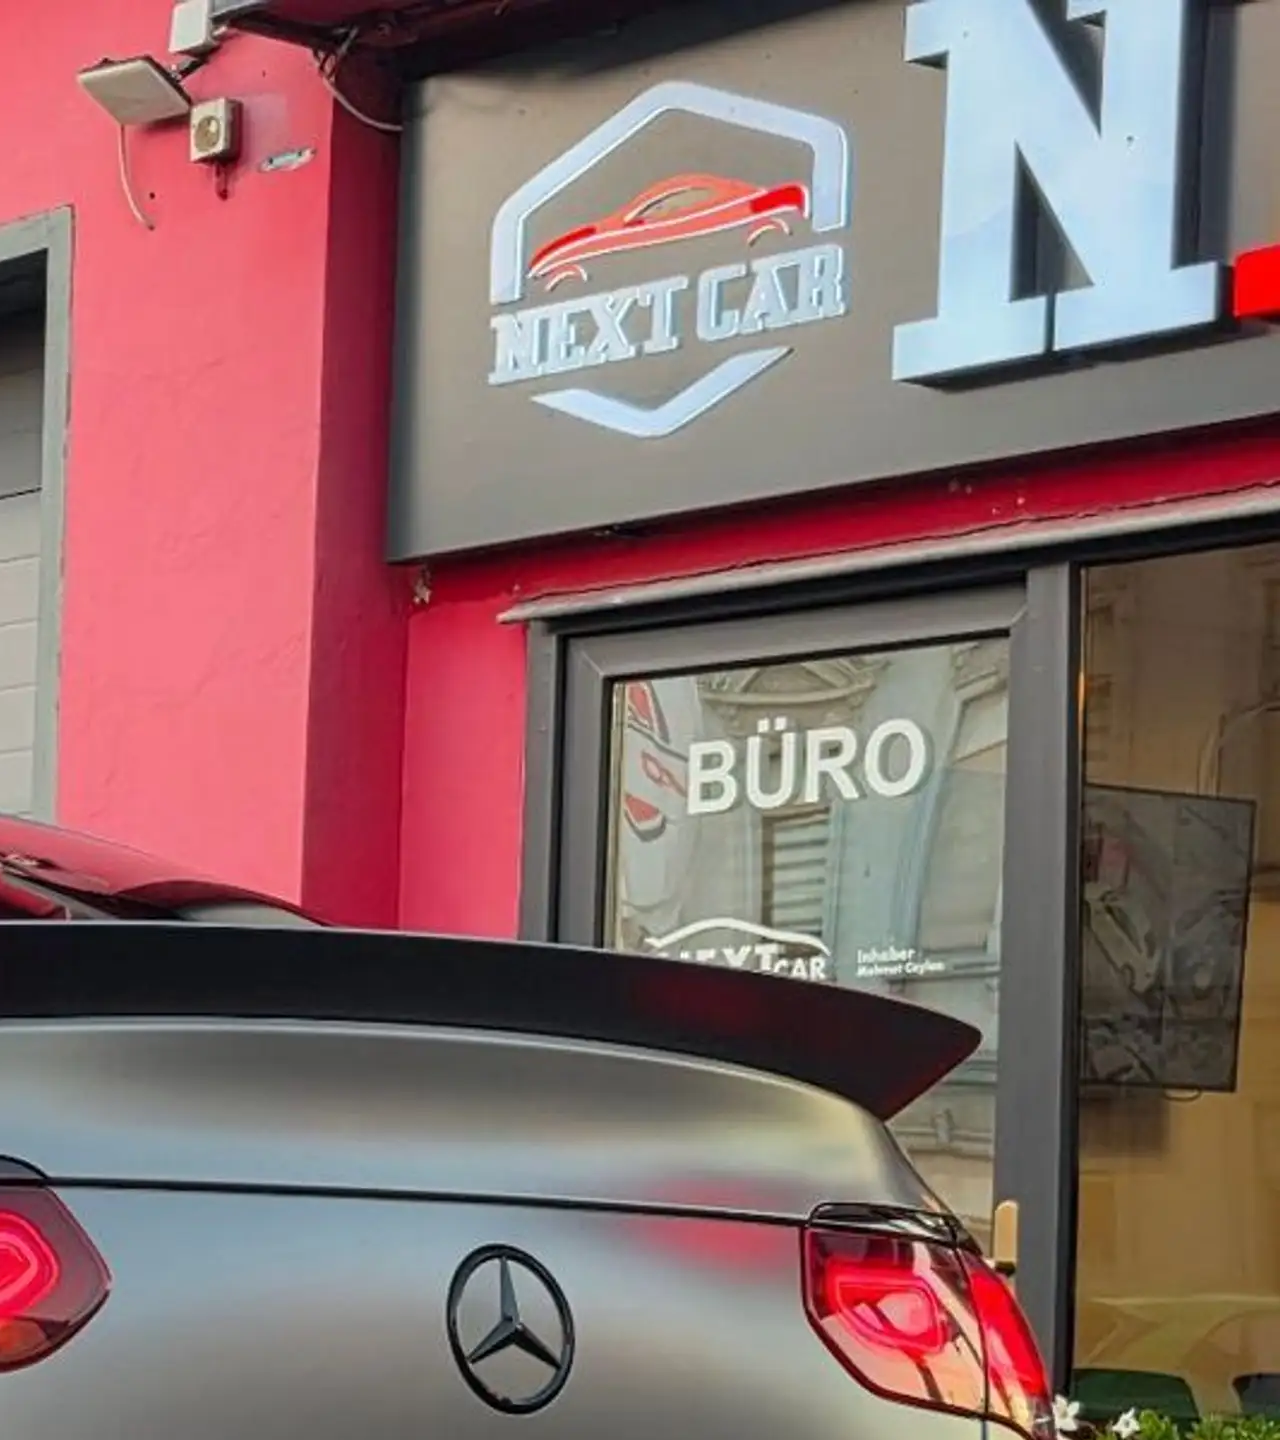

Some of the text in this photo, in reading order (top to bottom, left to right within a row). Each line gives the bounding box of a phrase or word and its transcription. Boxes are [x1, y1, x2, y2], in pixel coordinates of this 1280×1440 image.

[488, 243, 850, 385] NEXT CAR
[686, 716, 927, 815] BÜRO
